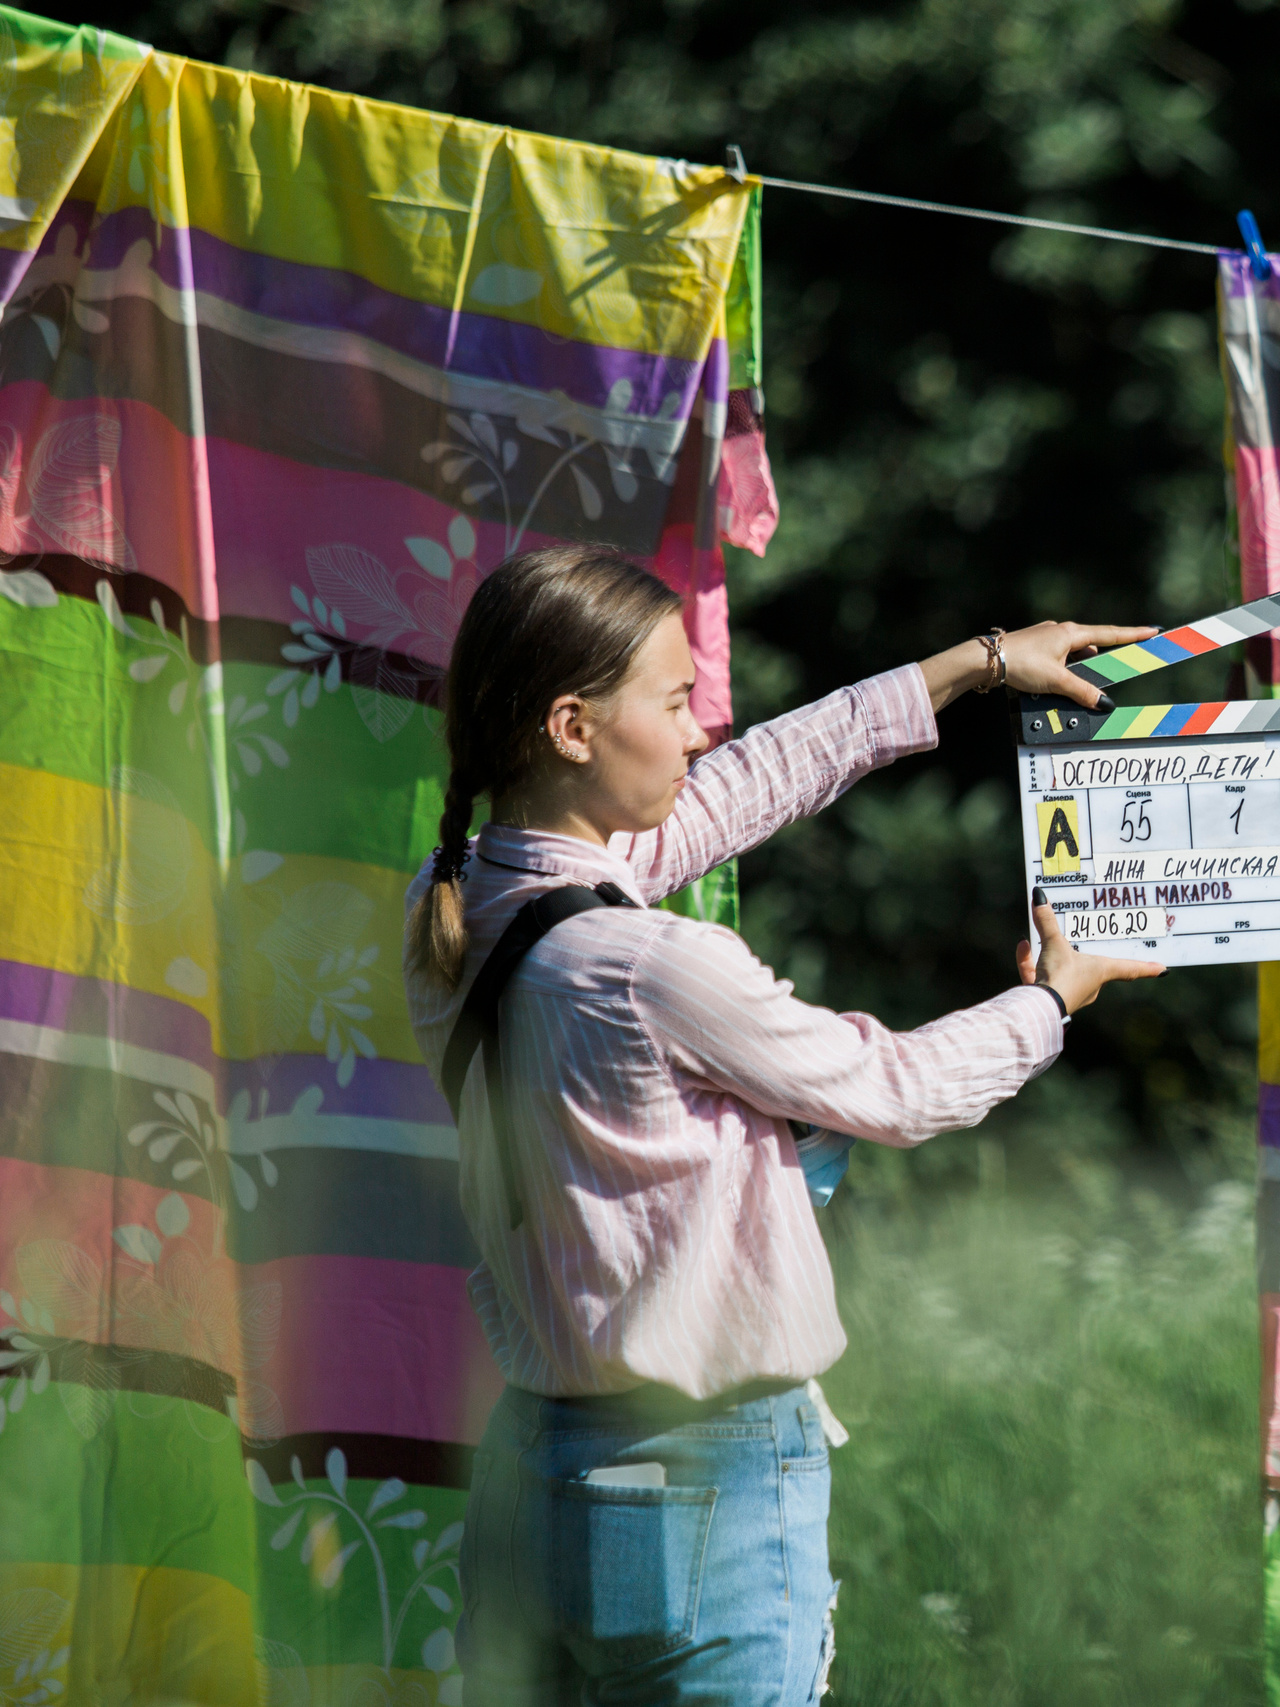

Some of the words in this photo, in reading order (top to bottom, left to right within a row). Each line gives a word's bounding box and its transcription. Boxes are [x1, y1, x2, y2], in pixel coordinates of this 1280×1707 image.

[1125, 790, 1152, 798] Сцена
[1225, 785, 1246, 793] Кадр
[1043, 794, 1074, 802] Камера
[1120, 799, 1153, 843] 55
[1230, 798, 1245, 835] 1
[1104, 860, 1145, 882] АННА
[1164, 855, 1278, 879] СИЧИНСКАЯ
[1035, 872, 1088, 884] Режиссёр
[1093, 886, 1147, 910] ИВАН
[1155, 881, 1232, 905] МАКАРОВ
[1051, 900, 1089, 911] ератор
[1071, 911, 1148, 938] 24.06.20
[1215, 936, 1230, 944] ISO
